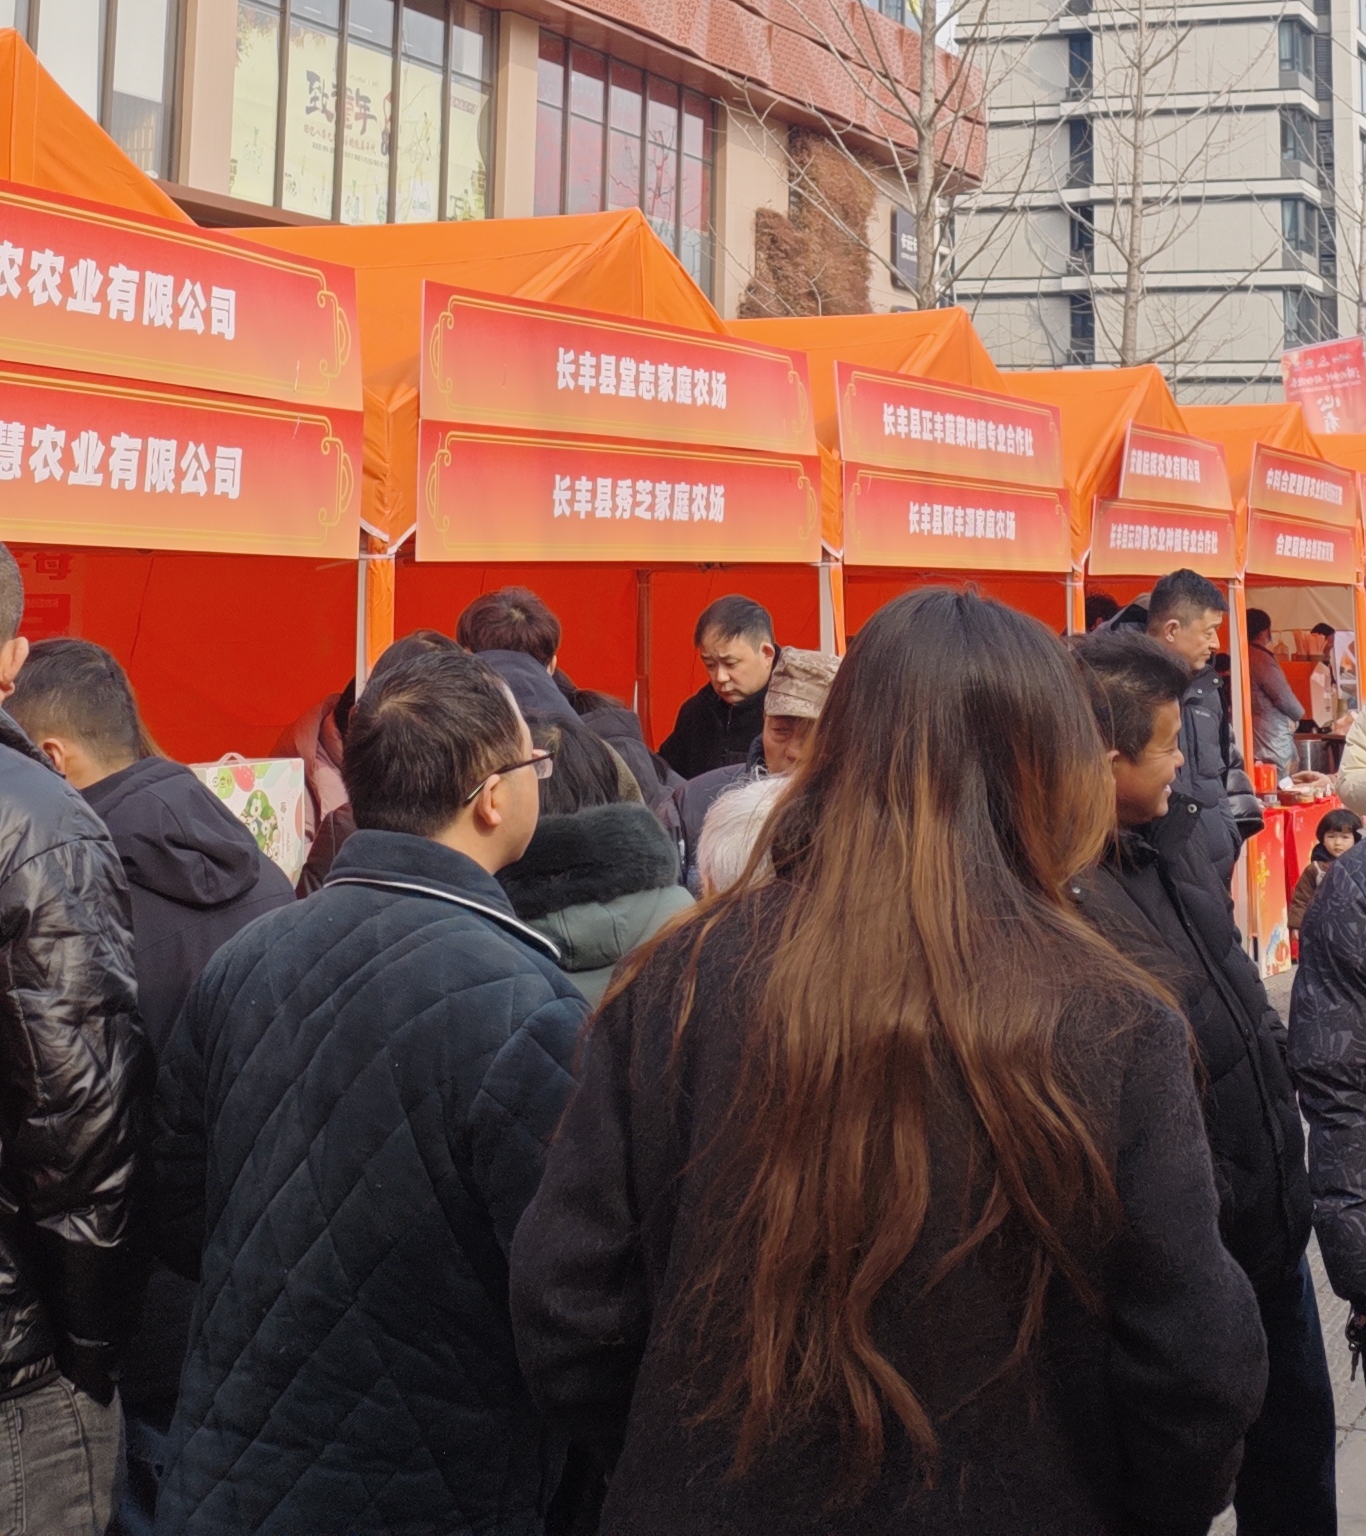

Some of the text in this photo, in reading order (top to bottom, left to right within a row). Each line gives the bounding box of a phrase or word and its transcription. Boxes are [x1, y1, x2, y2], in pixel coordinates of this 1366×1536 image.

[556, 347, 727, 410] 长丰县堂志家庭农场
[553, 474, 725, 523] 长丰县秀芝家庭农场
